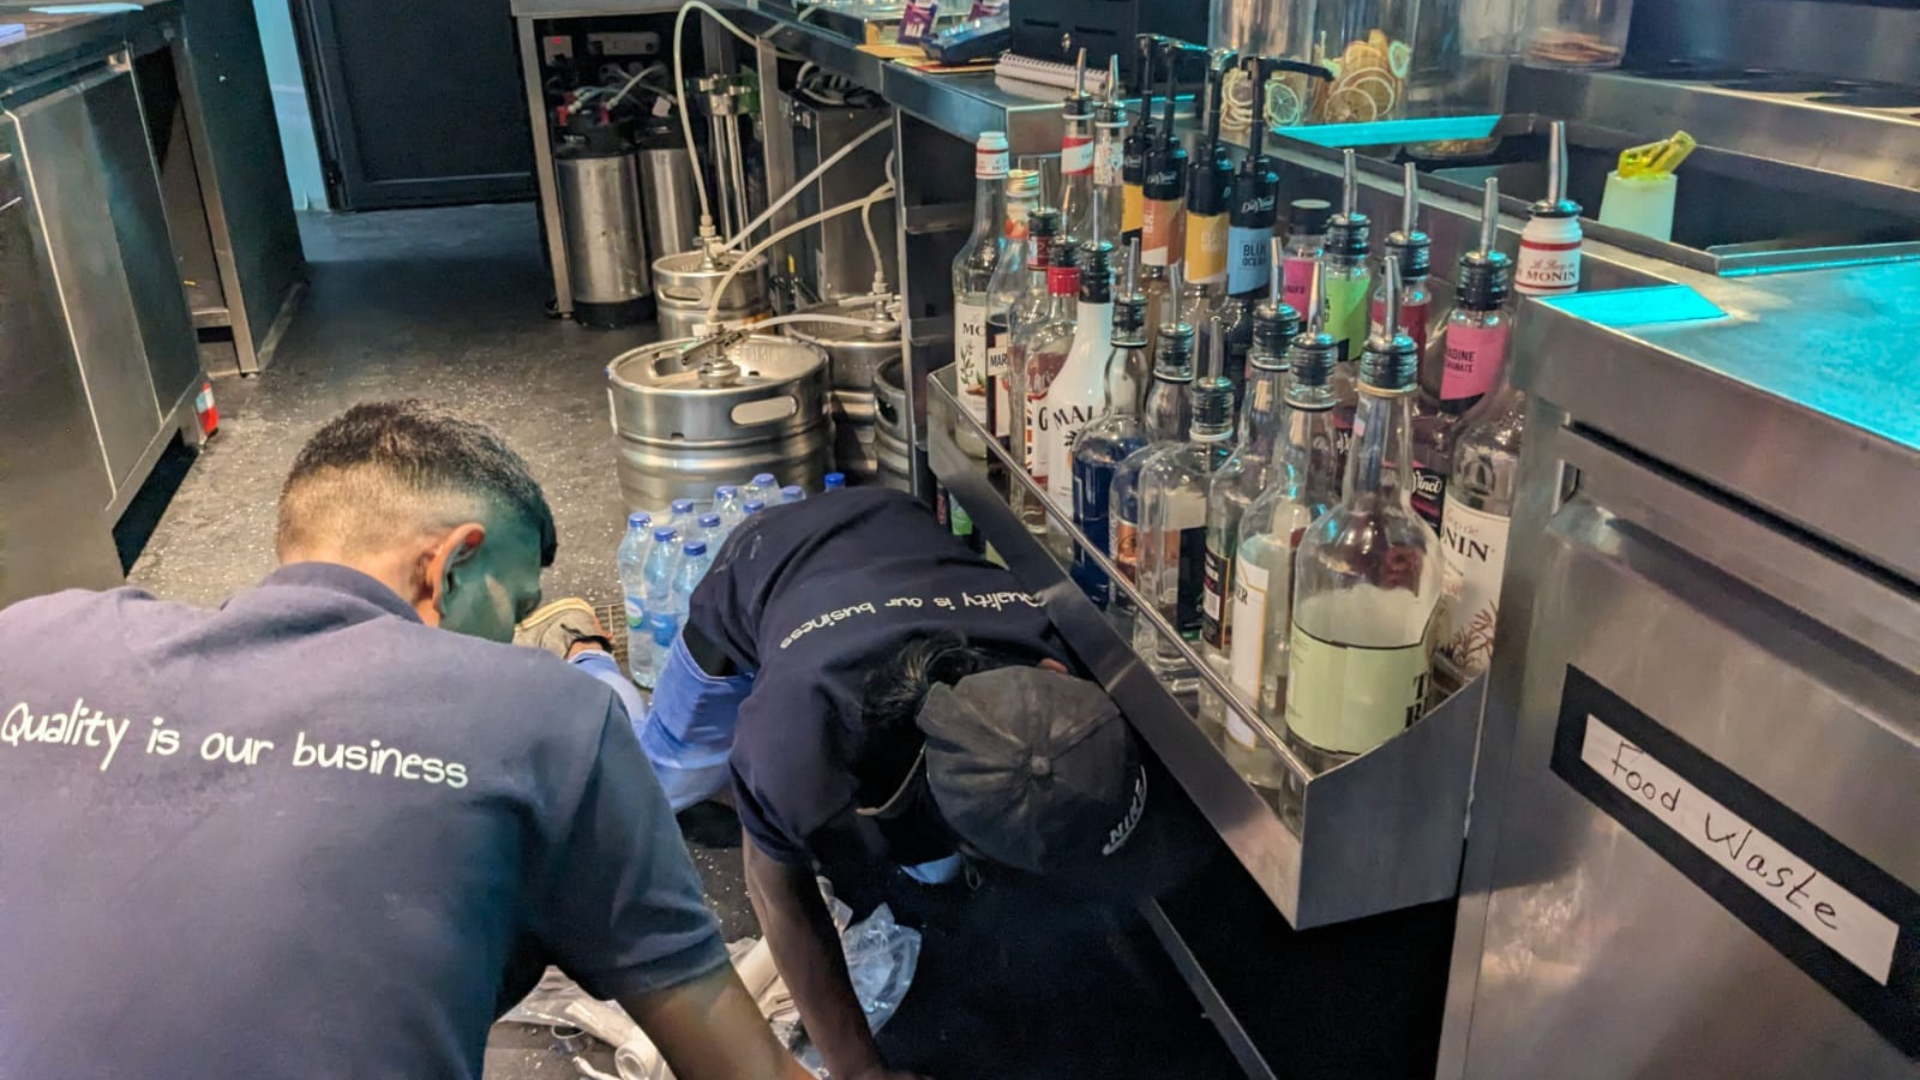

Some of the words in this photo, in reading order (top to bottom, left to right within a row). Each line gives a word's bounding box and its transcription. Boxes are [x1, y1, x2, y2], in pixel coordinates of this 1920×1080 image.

[1526, 270, 1575, 281] MONIN
[884, 598, 922, 608] our
[933, 598, 956, 610] is
[962, 591, 1048, 612] Quality
[780, 602, 876, 649] business
[1, 698, 130, 771] Quality
[146, 716, 180, 755] is
[200, 732, 274, 765] our
[292, 732, 468, 788] business
[1612, 740, 1681, 812] Food
[1704, 812, 1838, 930] Waste
